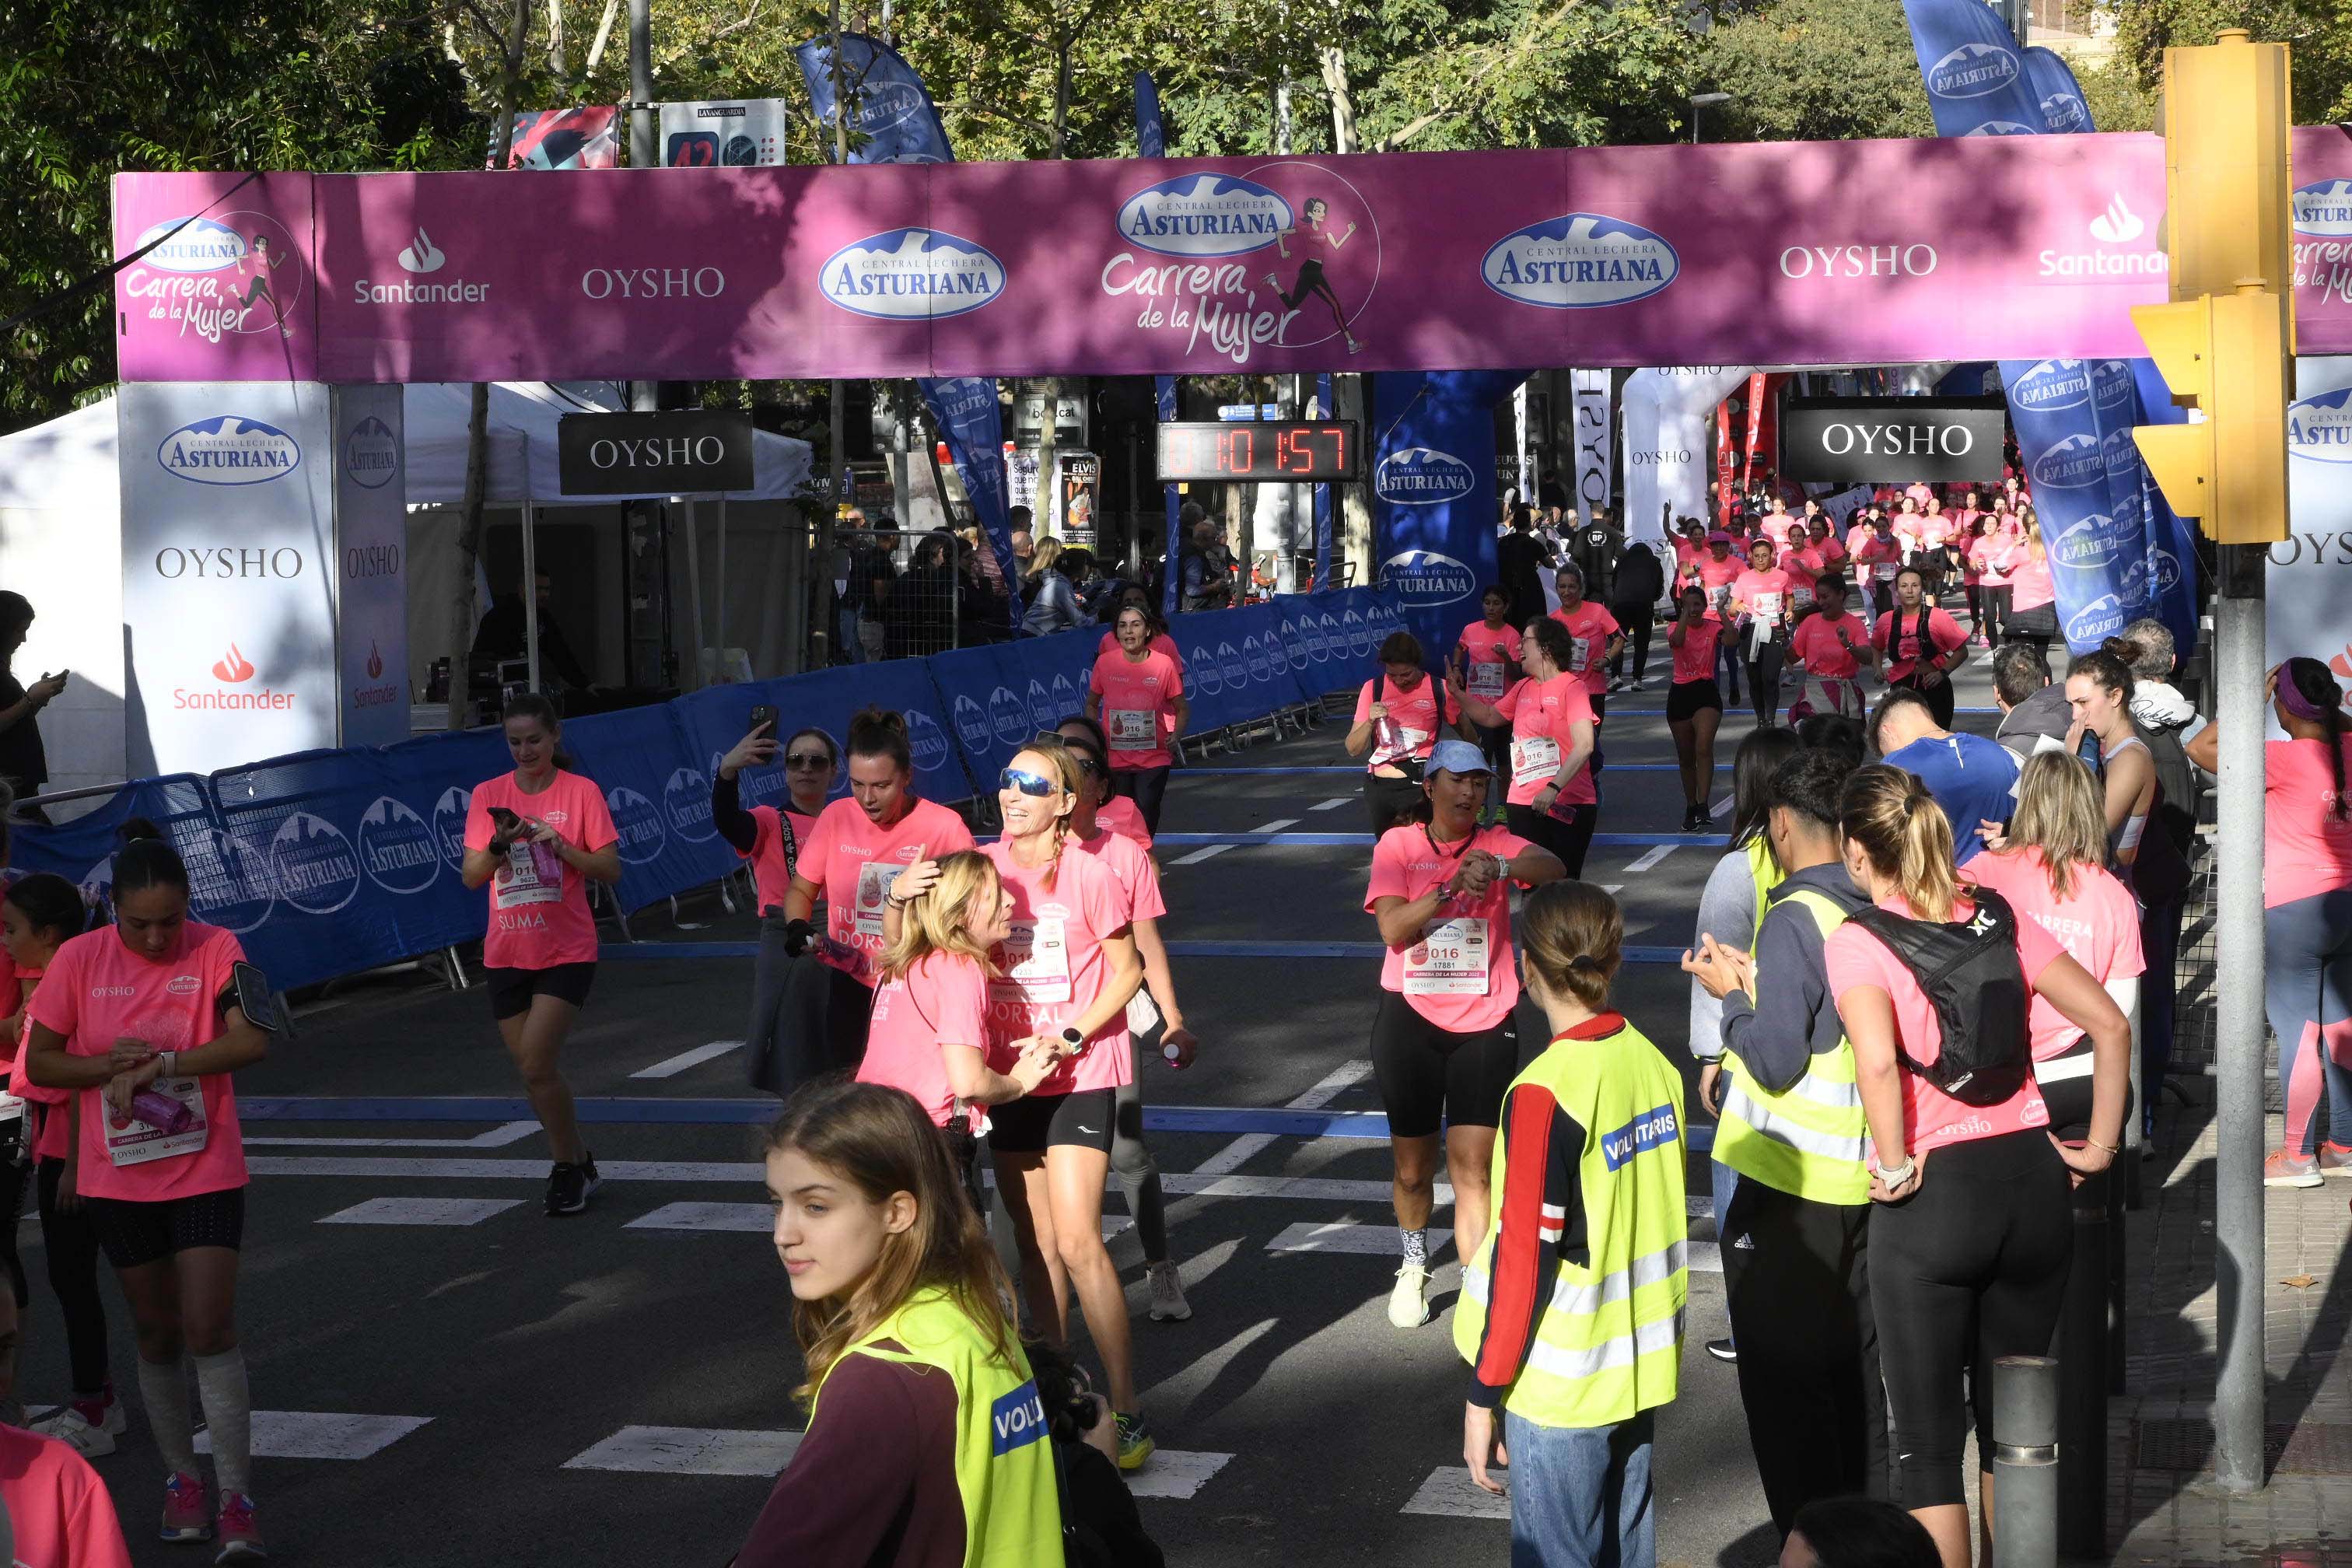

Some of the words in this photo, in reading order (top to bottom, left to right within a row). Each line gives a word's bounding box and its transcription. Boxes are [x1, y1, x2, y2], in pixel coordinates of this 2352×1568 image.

[1157, 201, 1214, 211] CENTRAL
[1217, 200, 1274, 210] LECHERA
[1129, 205, 1279, 236] ASTURIANA
[1527, 246, 1588, 257] CENTRAL
[1594, 244, 1657, 255] LECHERA
[1780, 243, 1938, 279] OYSHO
[2294, 242, 2352, 264] arrer
[862, 259, 921, 268] CENTRAL
[926, 258, 985, 268] LECHERA
[1101, 252, 1247, 296] Carrera
[1496, 250, 1664, 285] ASTURIANA
[125, 268, 218, 298] Carrera
[582, 267, 725, 299] OYSHO
[833, 261, 992, 296] ASTURIANA
[2312, 264, 2326, 286] la
[355, 278, 490, 304] Santander
[149, 301, 166, 320] de
[170, 299, 182, 320] la
[180, 296, 254, 344] Mujer
[1137, 298, 1164, 328] de
[1171, 297, 1189, 328] la
[1185, 290, 1301, 363] Mujer
[1033, 407, 1076, 418] b.cat
[1822, 423, 1973, 457] OYSHO
[168, 442, 291, 468] ASTURIANA
[590, 436, 725, 468] OYSHO
[1495, 455, 1533, 465] EUGS
[1632, 450, 1692, 465] OYSHO
[1073, 463, 1096, 474] ELVIS
[1379, 470, 1468, 492] ASTURIANA
[156, 548, 303, 579] OYSHO
[347, 544, 399, 579] OYSHO
[173, 688, 296, 710] Santander
[353, 684, 398, 709] Santander
[1527, 751, 1542, 761] 016
[366, 835, 437, 873] ASTURIANA
[840, 844, 873, 856] OYSHO
[278, 854, 357, 893] ASTURIANA
[1408, 862, 1441, 871] OYSHO
[498, 913, 546, 929] SUMA
[836, 906, 855, 924] TU
[2026, 910, 2093, 939] ARRERA
[1009, 953, 1035, 964] 016
[1431, 948, 1459, 958] 016
[91, 986, 135, 998] OYSHO
[989, 1003, 1064, 1026] ORSAL
[117, 1136, 143, 1145] CARRERA
[171, 1137, 203, 1149] Santander
[117, 1147, 146, 1159] OYSHO
[995, 1395, 1045, 1439] VOLU
